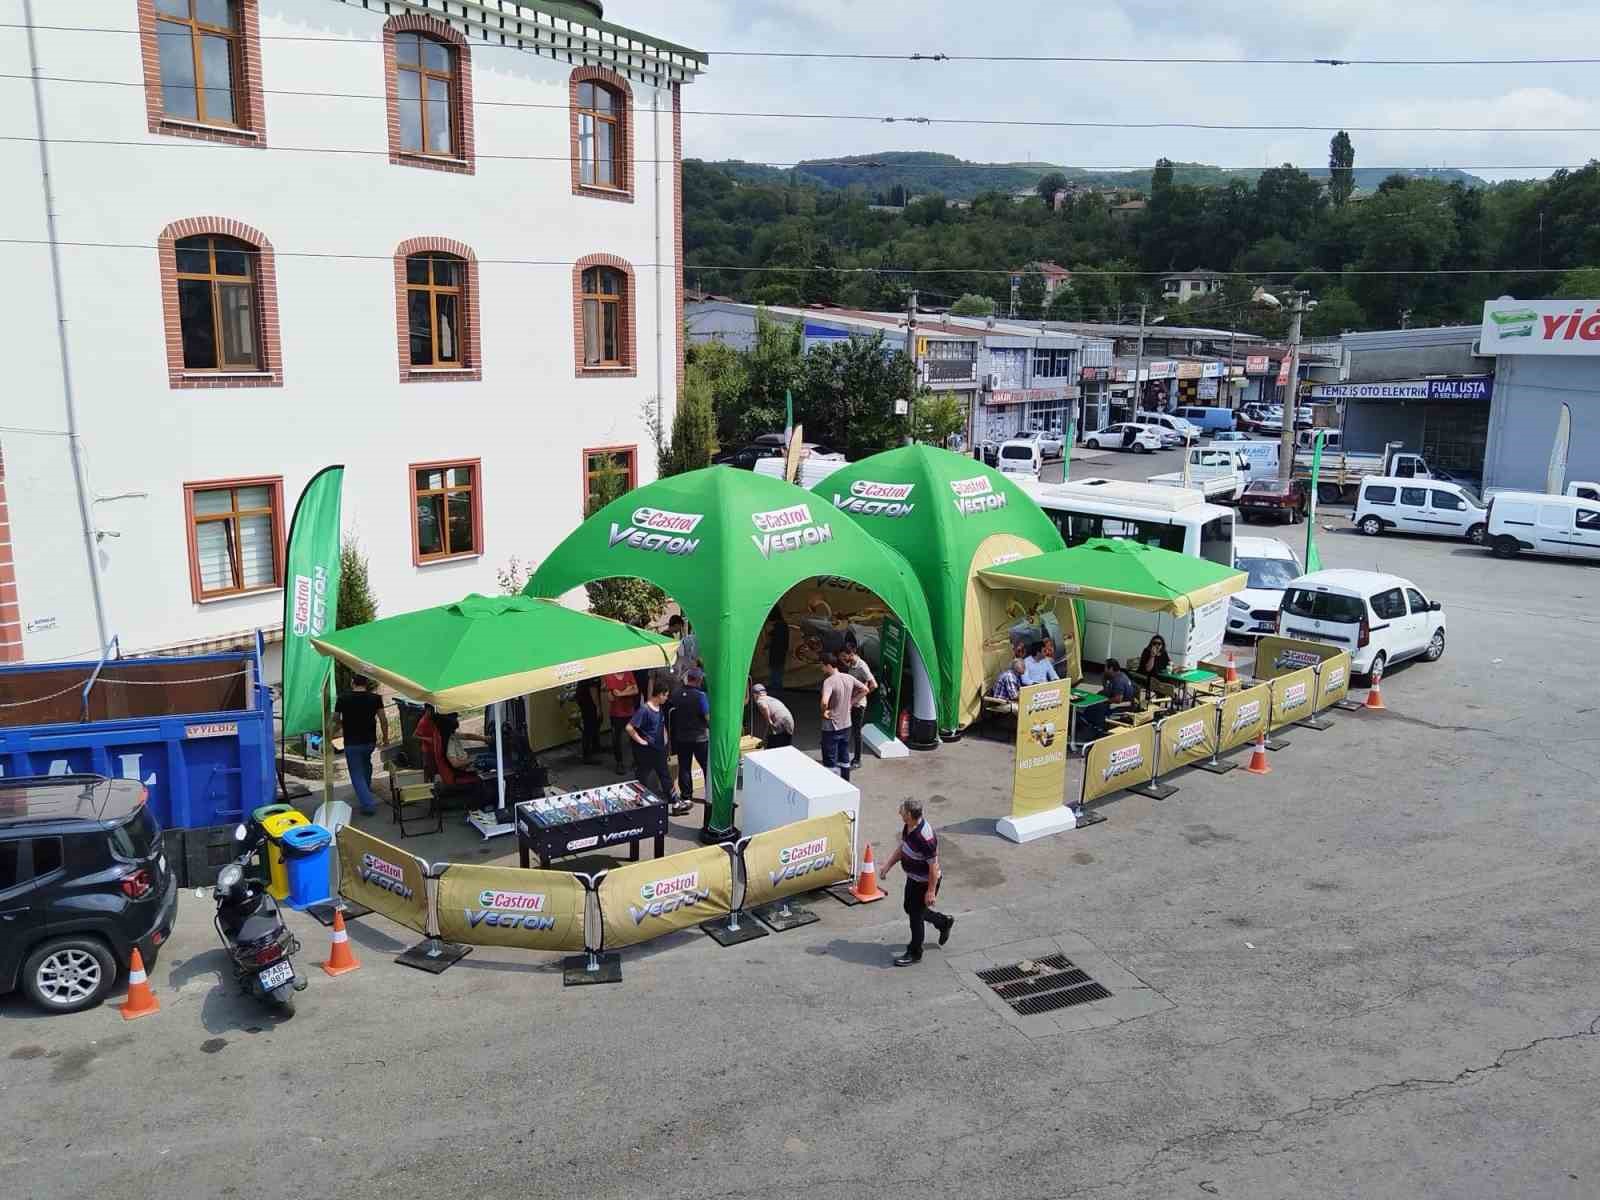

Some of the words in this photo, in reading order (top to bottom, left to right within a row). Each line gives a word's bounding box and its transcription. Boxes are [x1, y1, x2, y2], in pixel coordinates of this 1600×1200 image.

[1360, 386, 1380, 396] OTO
[1431, 382, 1458, 393] FUAT
[1459, 382, 1486, 393] USTA
[864, 484, 909, 498] Castrol
[832, 493, 916, 518] VECTON
[953, 491, 1008, 519] VECTON
[647, 510, 698, 532] Castrol
[766, 508, 810, 530] Castrol
[608, 522, 700, 556] VECTON
[751, 522, 833, 560] VECTON
[296, 579, 309, 625] Castrol
[789, 840, 825, 862] Castrol
[372, 856, 401, 880] Castrol
[768, 854, 835, 888] VECTON
[357, 866, 413, 901] VECTON
[654, 874, 696, 897] Castrol
[495, 892, 541, 910] Castrol
[628, 886, 711, 926] VECTON
[464, 907, 556, 930] VECTON
